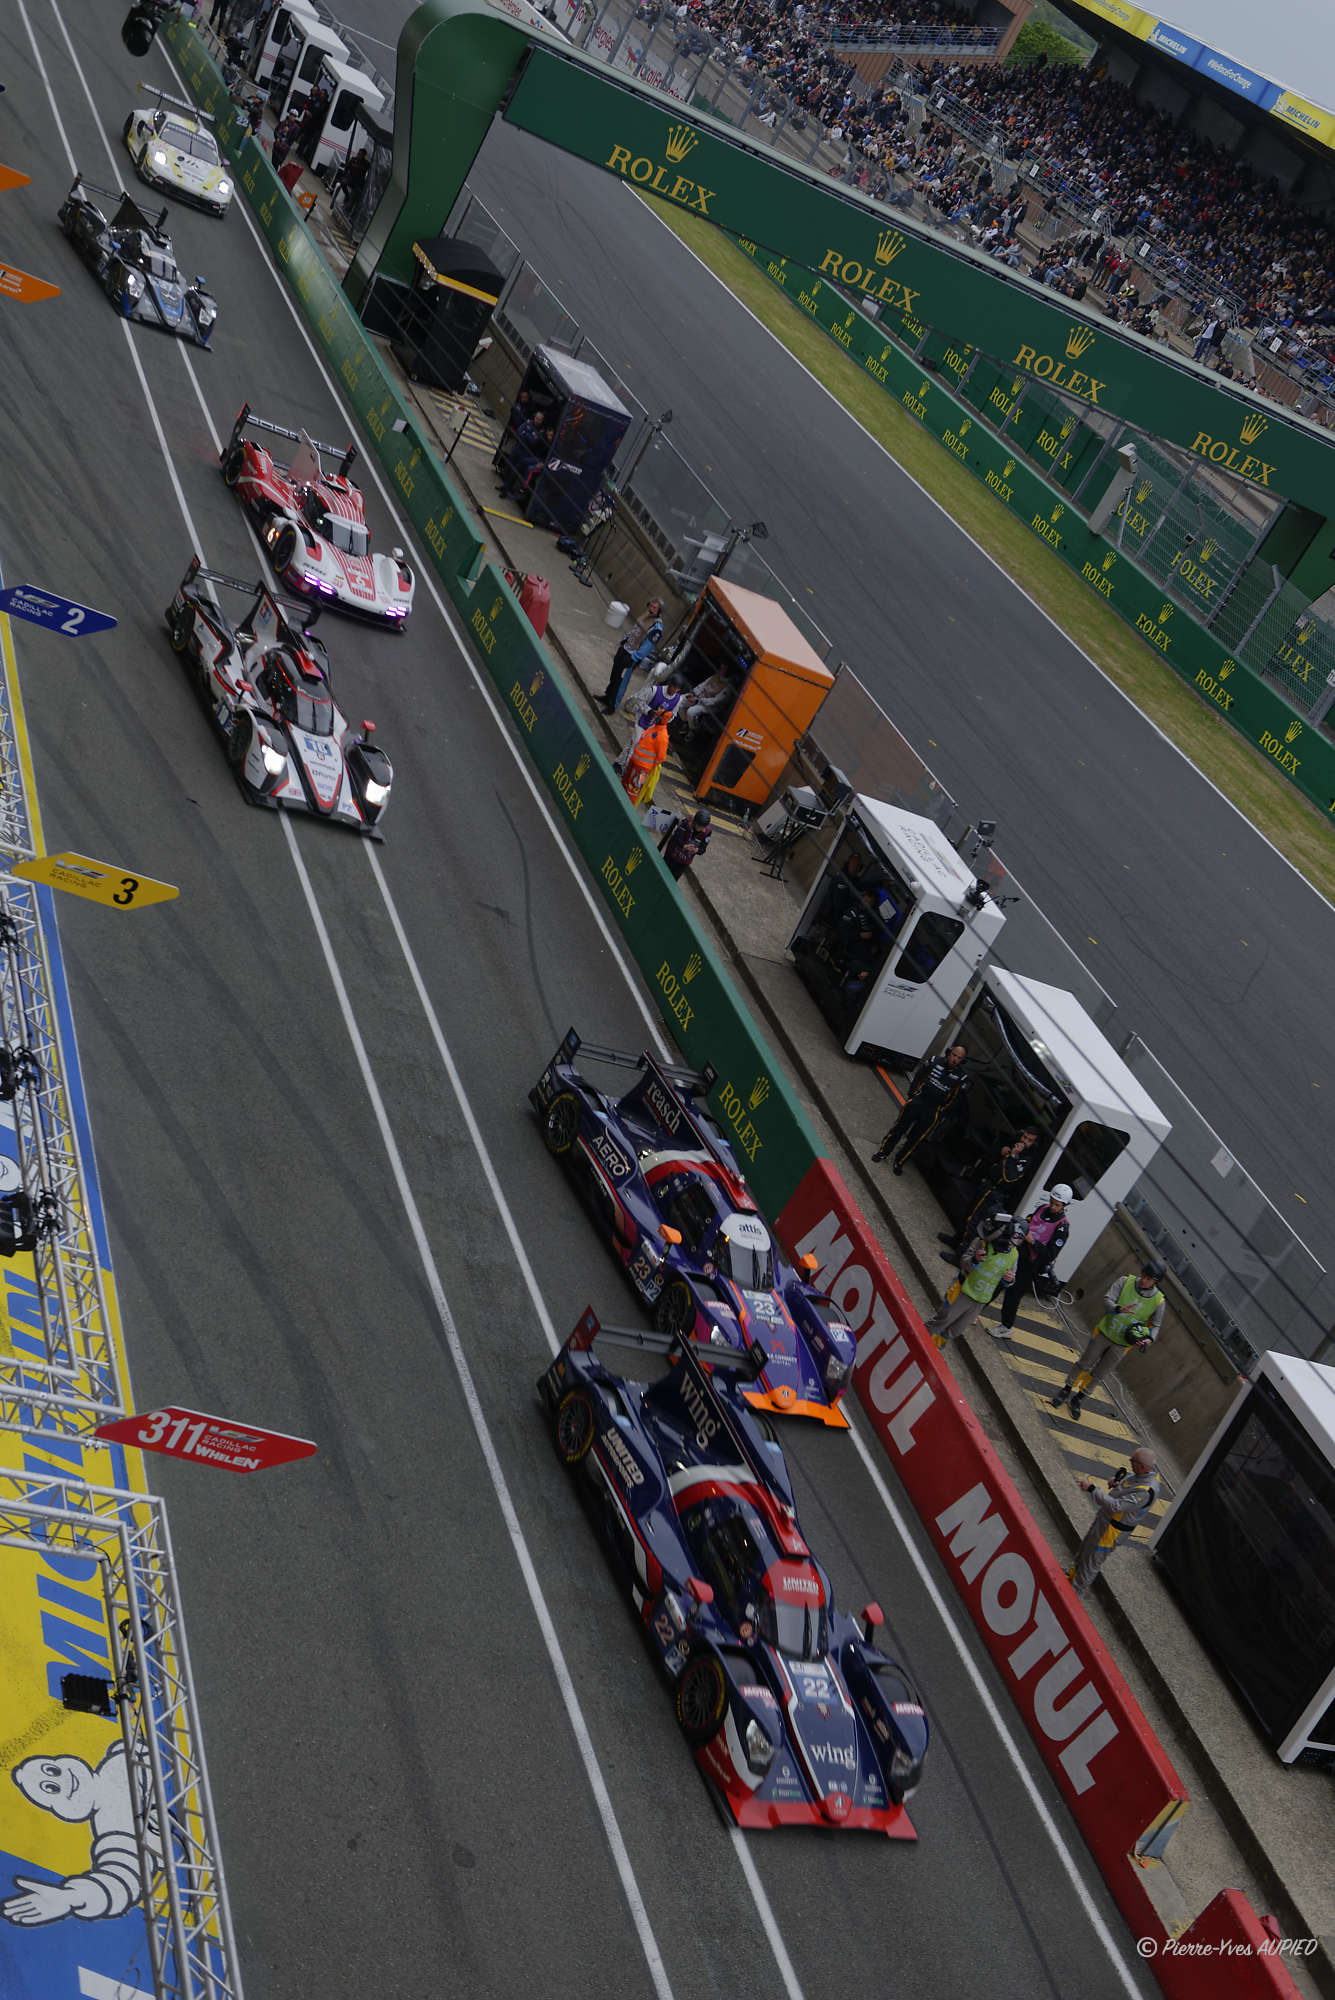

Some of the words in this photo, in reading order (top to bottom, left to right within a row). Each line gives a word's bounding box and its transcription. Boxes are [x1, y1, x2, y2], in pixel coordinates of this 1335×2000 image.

[1285, 104, 1321, 129] MICHELIN
[605, 144, 716, 215] ROLEX
[766, 261, 788, 287] ROLEX
[818, 248, 921, 314] ROLEX
[797, 289, 819, 317] ROLEX
[830, 321, 853, 349] ROLEX
[901, 314, 928, 339] ROLE
[865, 353, 889, 383] ROLEX
[942, 347, 970, 383] ROLE
[1012, 343, 1106, 404] ROLEX
[902, 391, 928, 420] ROLEX
[989, 386, 1024, 424] ROLX
[941, 429, 969, 460] ROLEX
[1036, 429, 1073, 470] ROLX
[1189, 430, 1279, 487] ROLEX
[394, 459, 416, 499] ROLEX
[984, 470, 1016, 503] ROLEX
[425, 520, 448, 560] ROLEX
[1031, 513, 1063, 549] ROLEX
[1081, 560, 1116, 599] ROLEX
[61, 607, 86, 635] 2
[471, 607, 497, 655] ROLEX
[1135, 614, 1174, 653] ROLEX
[510, 680, 538, 733] ROLEX
[1194, 668, 1235, 712] ROLEX
[1258, 730, 1301, 776] ROLEX
[552, 763, 584, 821] ROLEX
[113, 877, 139, 905] 3
[601, 855, 636, 920] ROLEX
[655, 960, 695, 1032] ROLEX
[718, 1081, 763, 1163] ROLEX
[592, 1135, 626, 1177] AERO
[738, 1221, 763, 1236] attis
[633, 1256, 651, 1280] 23
[645, 1281, 660, 1299] P2
[753, 1300, 775, 1316] 23
[793, 1209, 937, 1456] MOTUL
[680, 1370, 721, 1452] wing
[138, 1411, 207, 1454] 311
[201, 1439, 242, 1453] RACING
[204, 1435, 257, 1452] CADILLAC
[195, 1444, 261, 1469] WHELEN
[607, 1427, 645, 1484] UNITED
[654, 1613, 675, 1648] 22
[934, 1481, 1121, 1796] MOTUL
[803, 1678, 831, 1698] 22
[810, 1741, 856, 1771] wing
